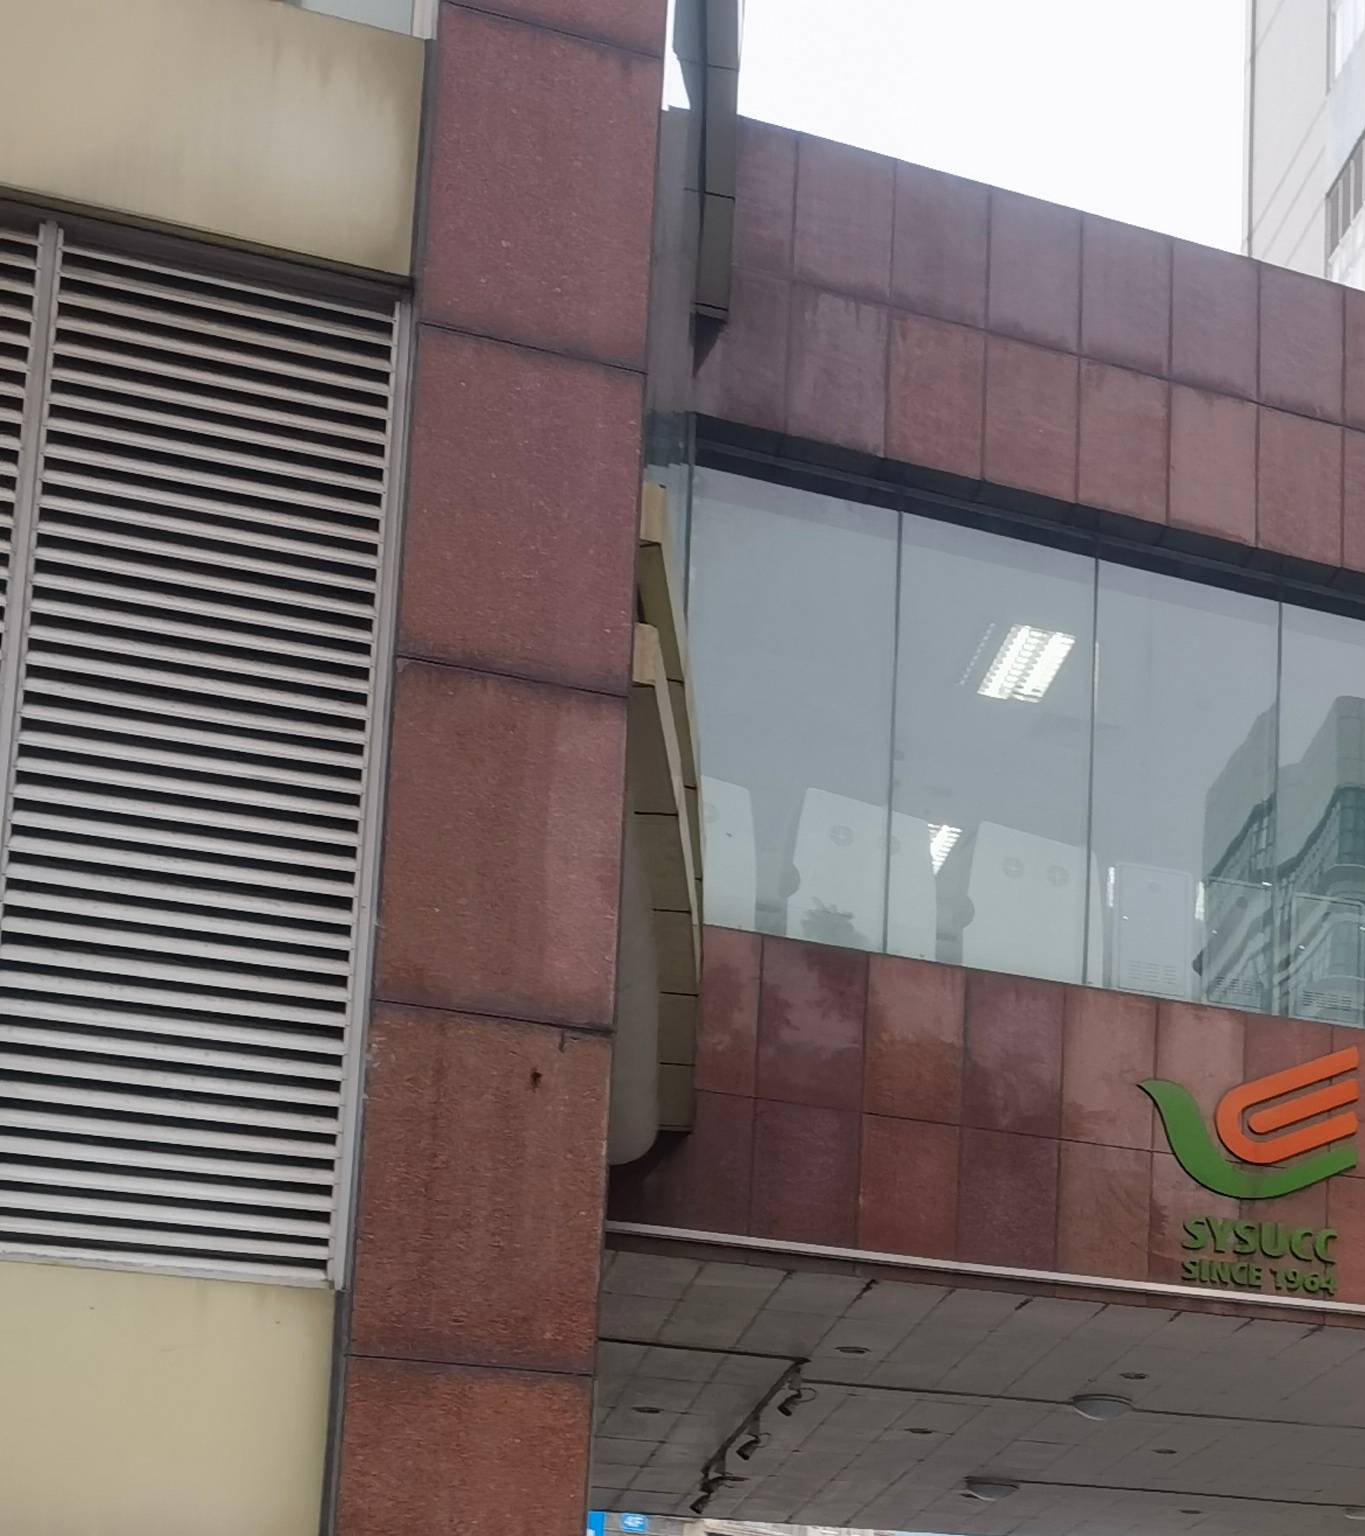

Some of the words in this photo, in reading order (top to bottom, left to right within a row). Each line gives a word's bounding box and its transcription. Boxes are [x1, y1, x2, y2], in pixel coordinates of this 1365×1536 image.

[1182, 1217, 1338, 1265] SYSUCC
[1181, 1258, 1263, 1288] SINCE
[1269, 1268, 1338, 1296] 1964
